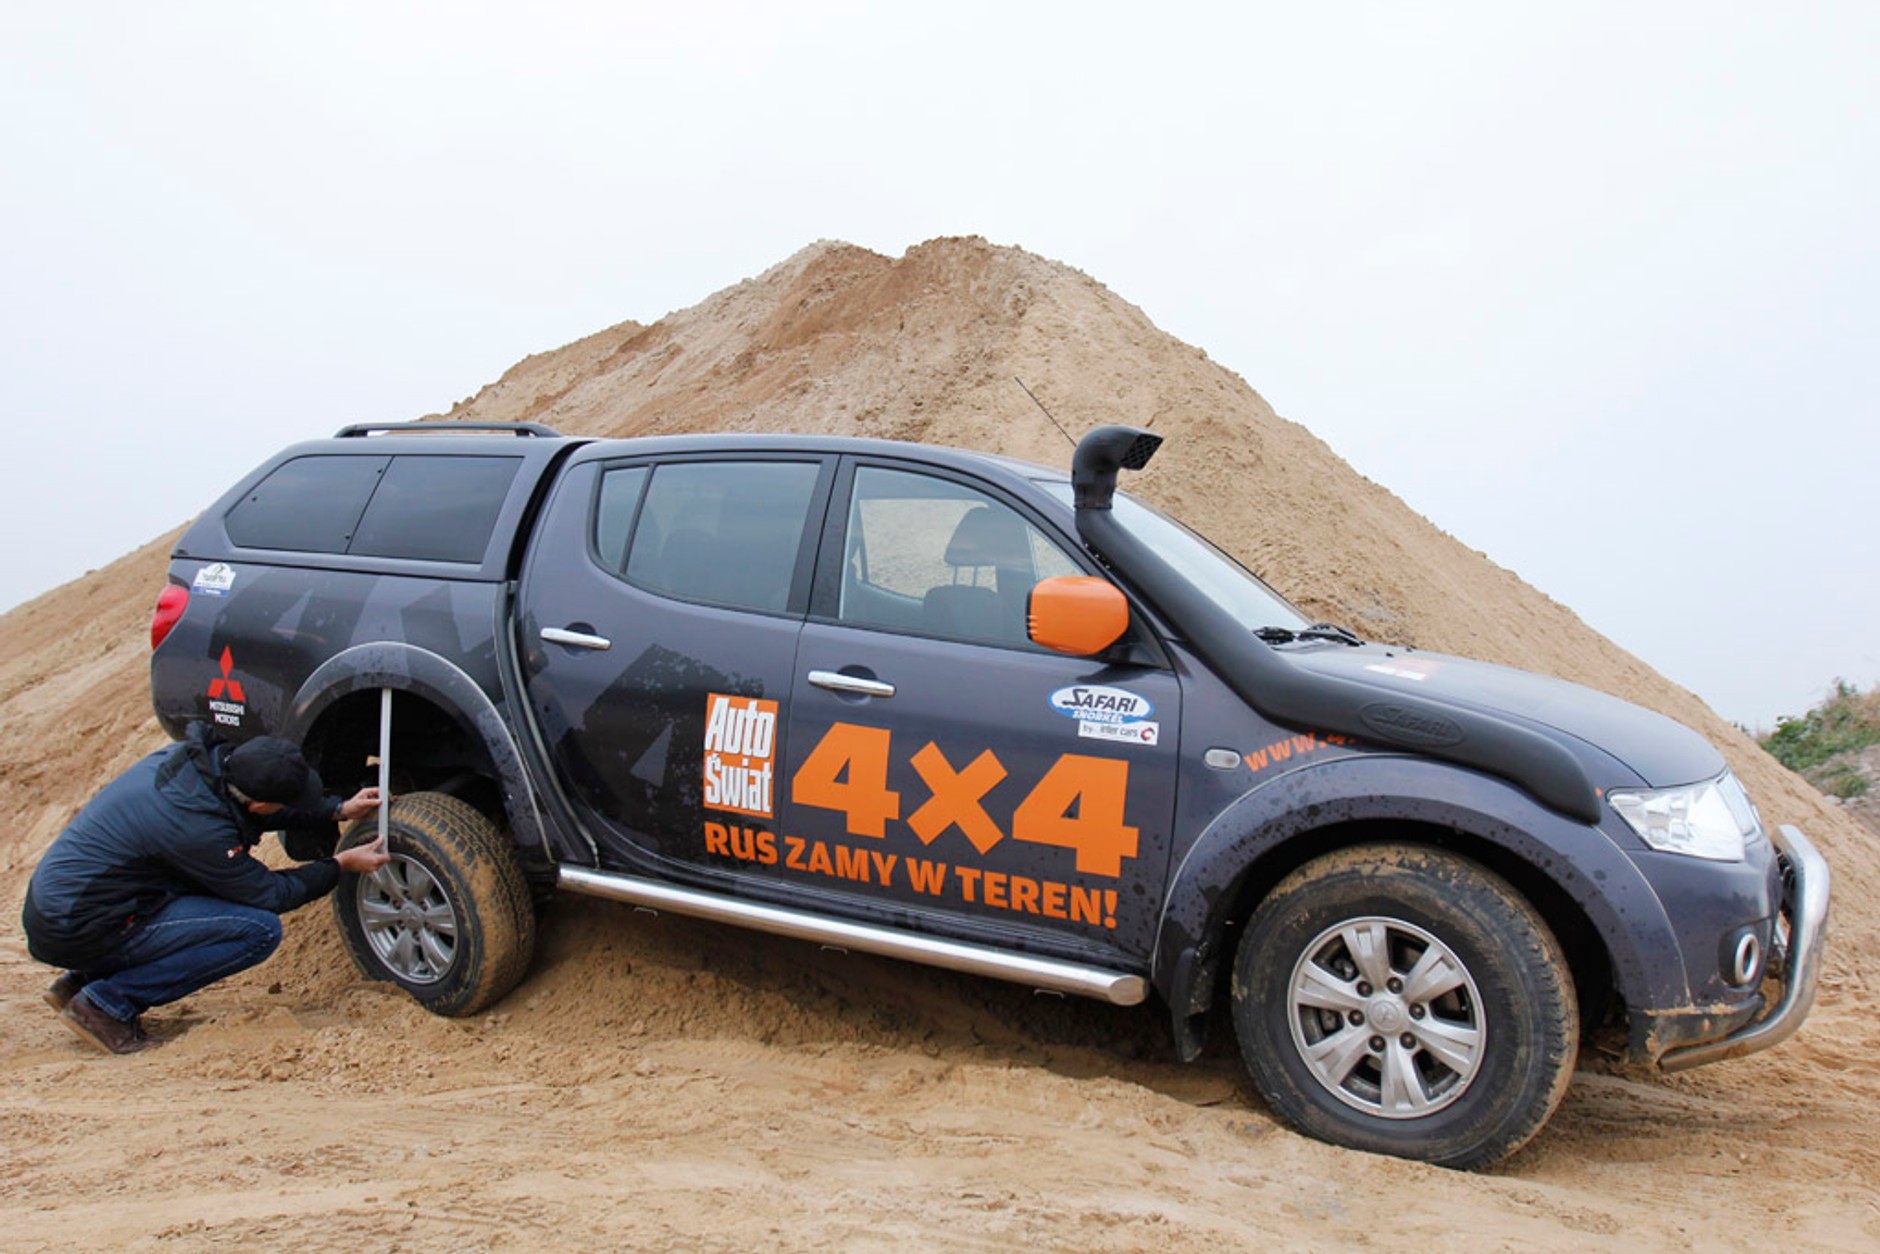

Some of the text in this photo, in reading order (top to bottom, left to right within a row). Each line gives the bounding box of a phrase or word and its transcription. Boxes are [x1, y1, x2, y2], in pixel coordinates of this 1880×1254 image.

[705, 697, 774, 754] Auto
[1062, 688, 1138, 712] SAFARI
[1244, 732, 1356, 772] www.
[705, 753, 773, 813] Świat
[905, 857, 947, 896] W
[955, 866, 1119, 929] TEREN!
